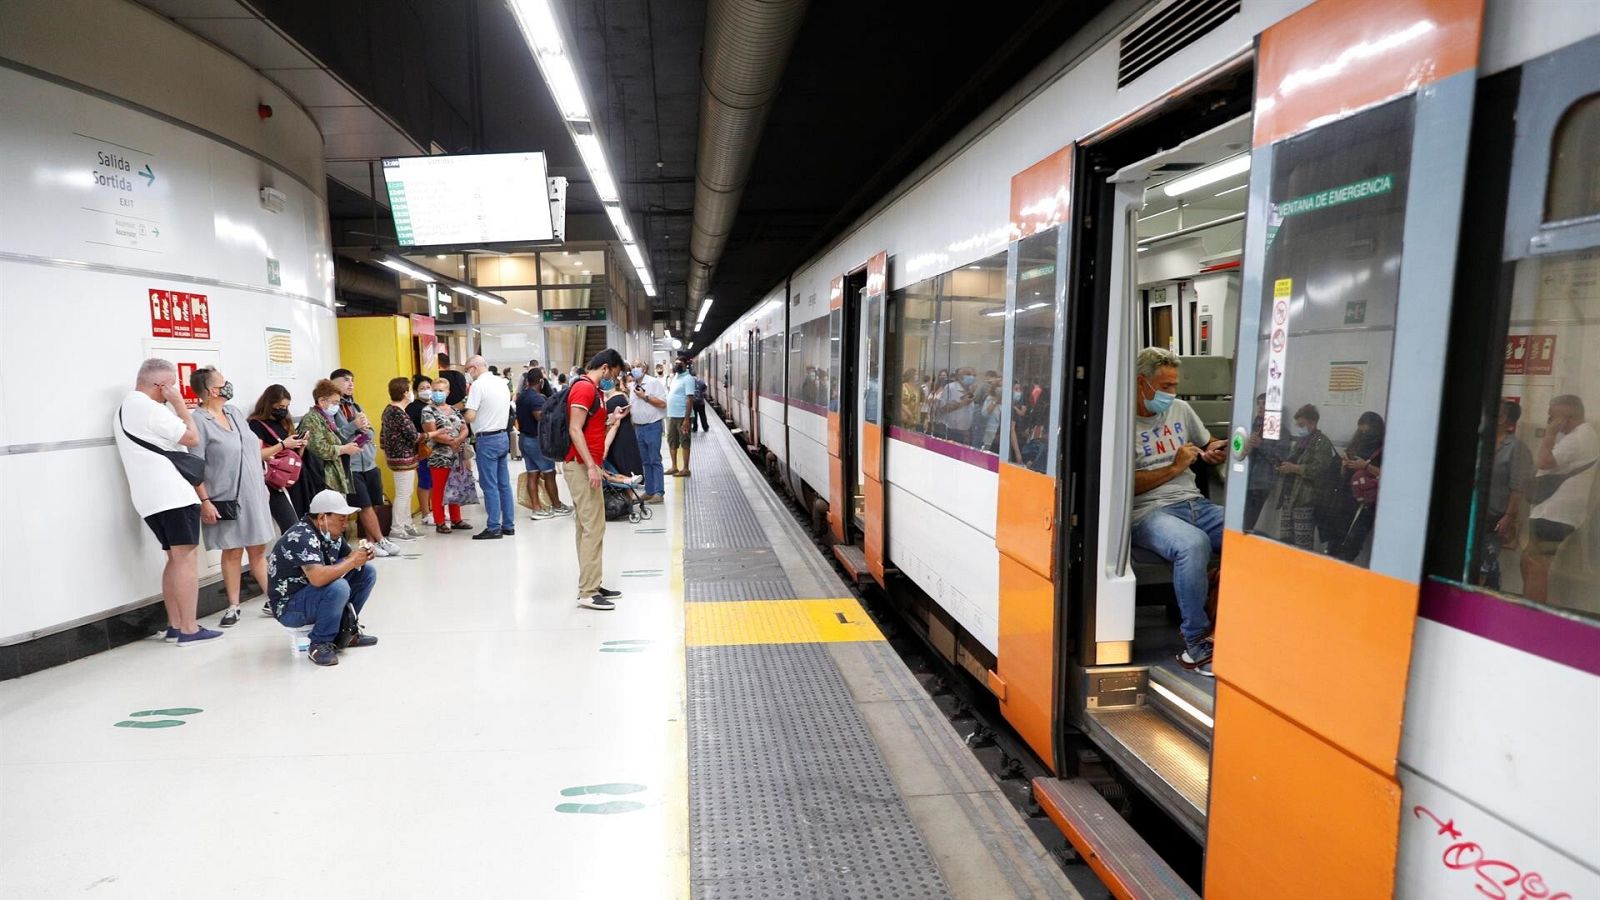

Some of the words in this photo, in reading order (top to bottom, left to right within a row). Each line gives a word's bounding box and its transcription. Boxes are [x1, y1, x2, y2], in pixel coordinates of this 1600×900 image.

[97, 151, 131, 172] Salida
[92, 170, 133, 192] Sortida
[1315, 192, 1328, 208] DE
[1329, 175, 1392, 205] EMERGENCIA
[119, 197, 135, 208] EXIT
[1141, 422, 1182, 443] STAR
